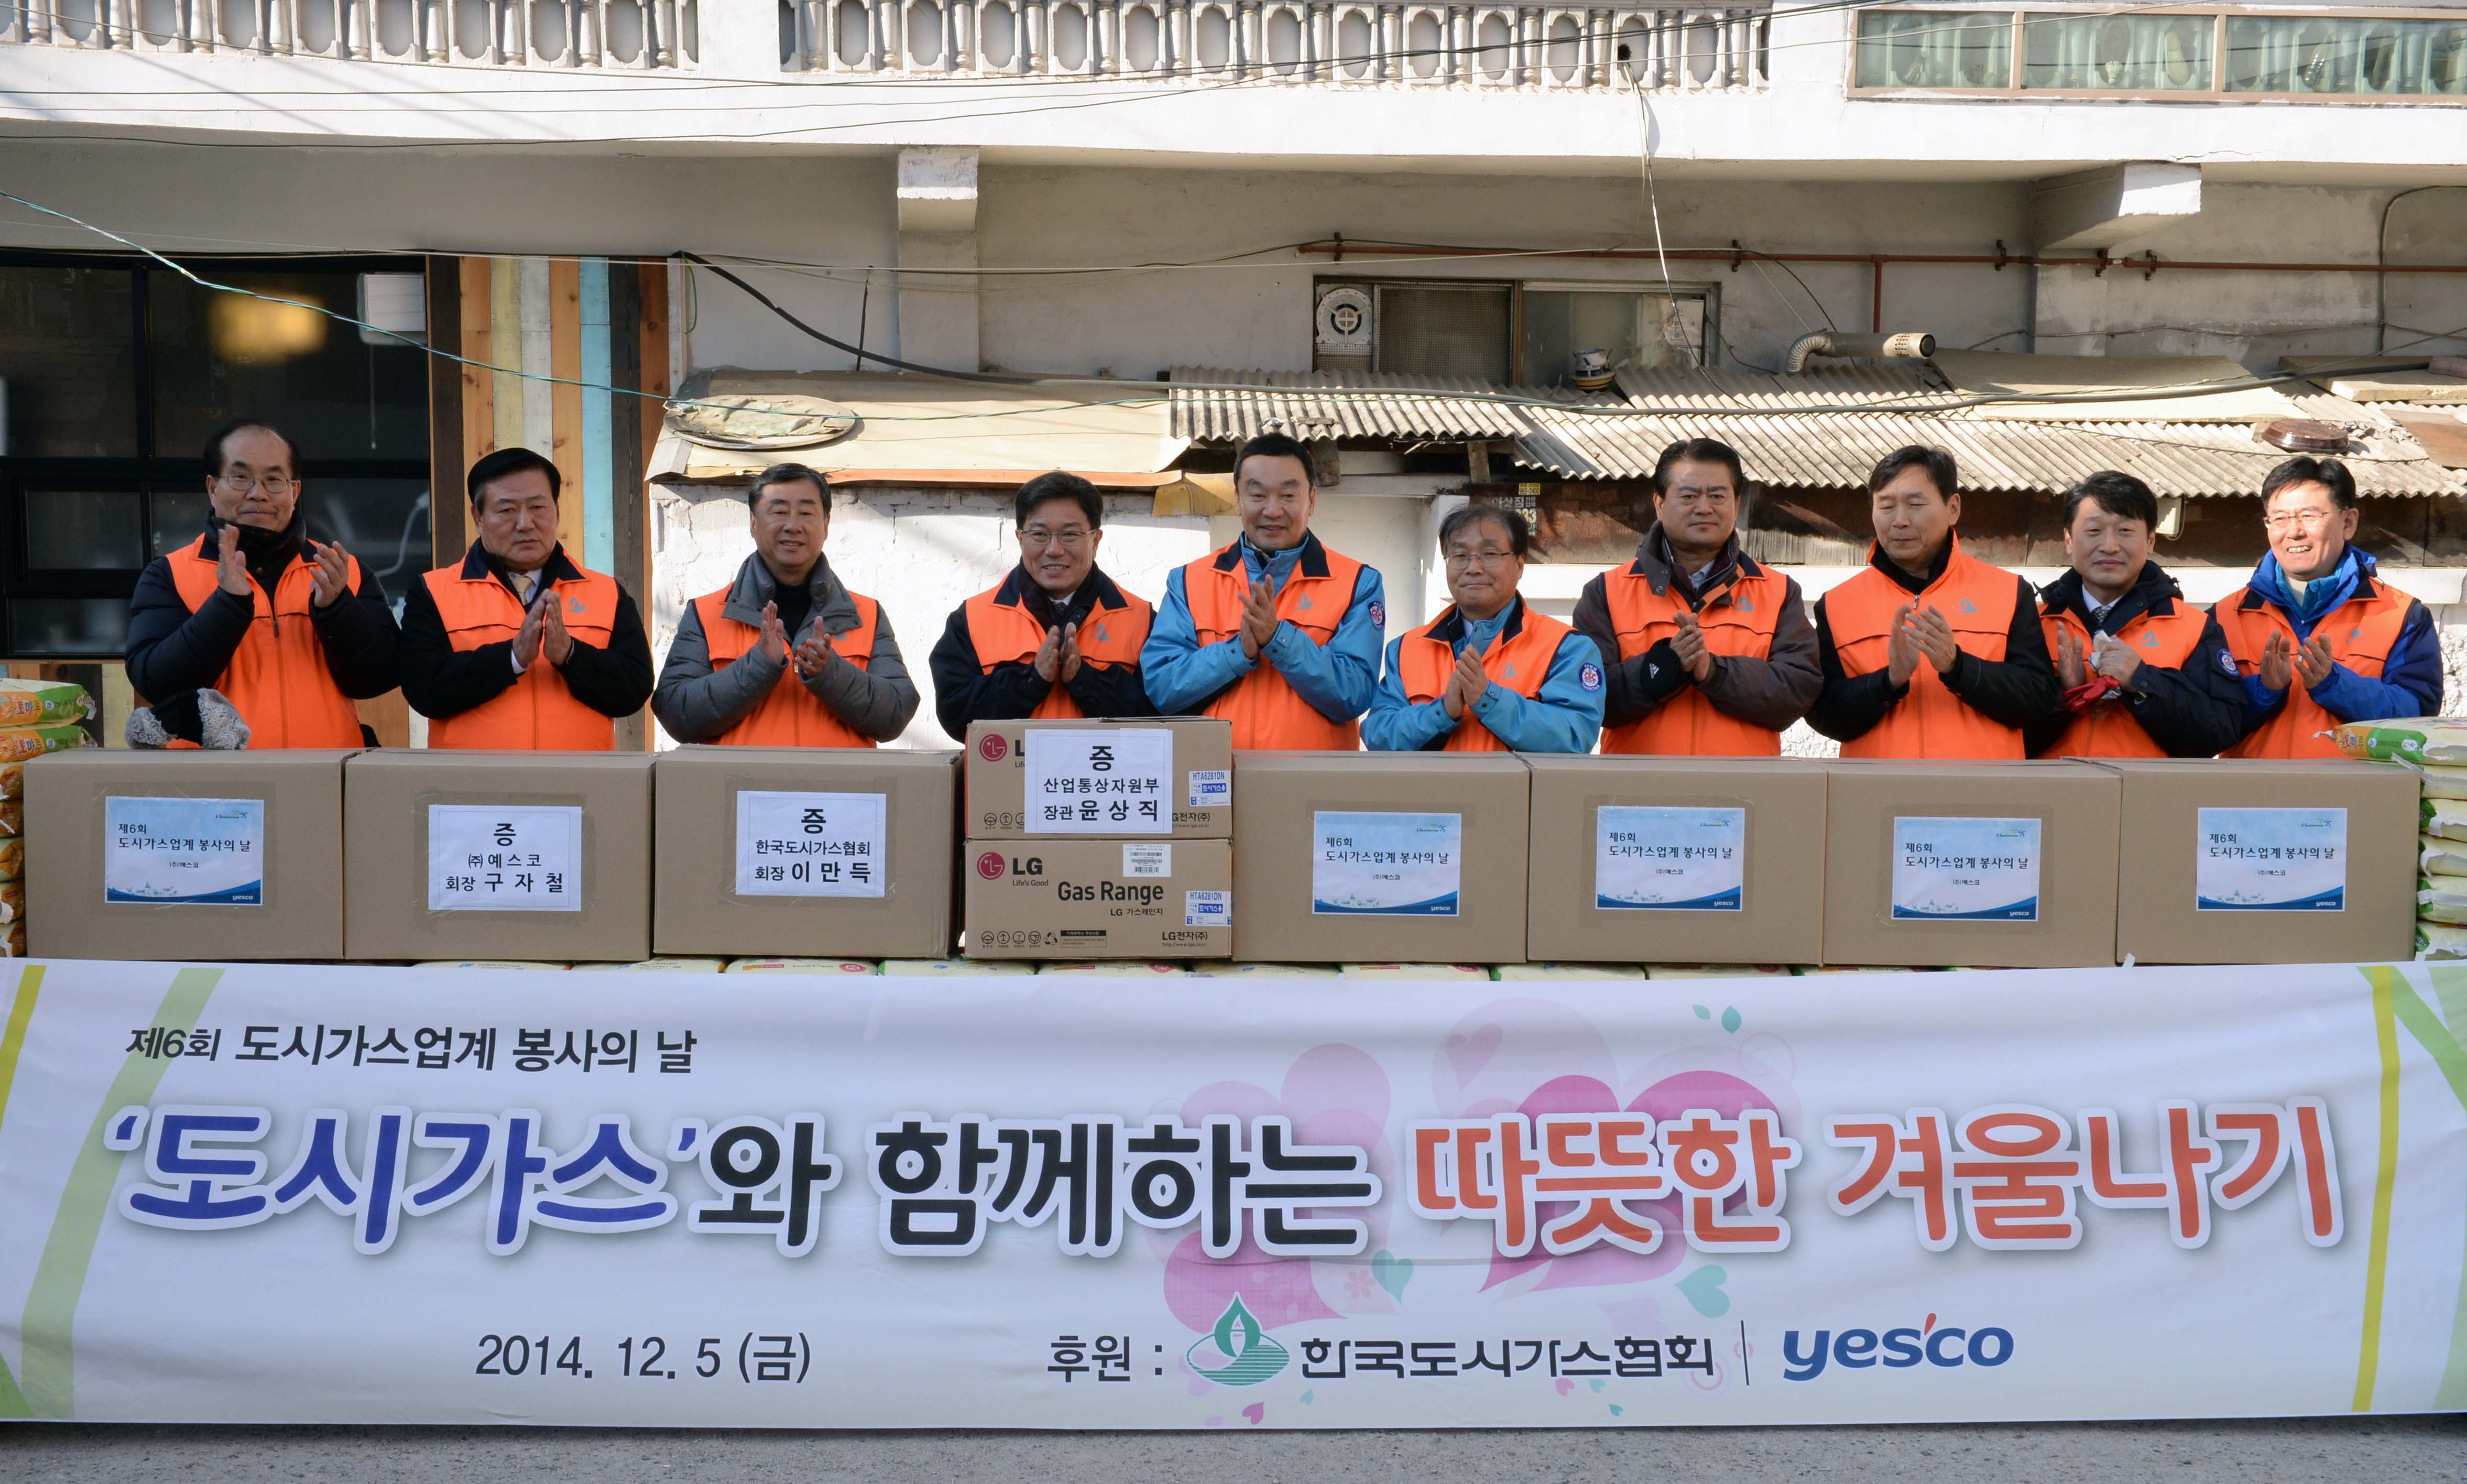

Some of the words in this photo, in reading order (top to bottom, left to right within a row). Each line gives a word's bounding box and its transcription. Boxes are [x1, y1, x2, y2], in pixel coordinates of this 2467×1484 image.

[1015, 740, 1024, 756] L
[1089, 746, 1114, 771] 증
[1193, 772, 1225, 781] HTA6281DN
[1044, 778, 1159, 793] 산업통상자원부
[1044, 805, 1073, 820] 장관
[801, 809, 826, 834] 증
[119, 824, 146, 834] 제6회
[494, 824, 516, 846] 증
[1326, 838, 1351, 847] 제6회
[1610, 833, 1635, 842] 제6회
[2210, 834, 2236, 843] 제6회
[119, 838, 193, 850] 도시가스업계
[199, 839, 234, 851] 봉사의
[240, 841, 250, 852] 날
[756, 840, 869, 856] 한국도시가스협회
[1610, 846, 1678, 857] 도시가스업계
[1684, 847, 1717, 858] 봉사의
[1722, 848, 1732, 858] 날
[1906, 843, 1931, 853] 제6회
[1326, 851, 1395, 863] 도시가스업계
[1400, 853, 1433, 864] 봉사의
[1439, 853, 1449, 864] 날
[2210, 847, 2280, 858] 도시가스업계
[2286, 848, 2319, 859] 봉사의
[2324, 848, 2335, 859] 날
[1013, 858, 1042, 875] LG
[1906, 857, 1975, 868] 도시가스업계
[1980, 858, 2013, 869] 봉사의
[2018, 858, 2028, 869] 날
[755, 866, 784, 881] 회장
[446, 877, 475, 891] 회장
[1058, 881, 1095, 901] Gas
[1101, 881, 1163, 905] Range
[1190, 891, 1221, 900] HTA6281DN
[1162, 932, 1207, 940] LG전자(주)
[126, 1027, 221, 1061] 제6회
[235, 1024, 496, 1070] 도시가스업계
[513, 1029, 637, 1073] 봉사의
[658, 1030, 697, 1073] 날
[876, 1122, 1371, 1250] 함께하는
[1416, 1118, 1791, 1247] 따뜻한
[1835, 1106, 2333, 1240] 겨울나기
[476, 1335, 592, 1378] 2014.
[618, 1337, 675, 1379] 12.
[696, 1339, 720, 1377] 5
[739, 1333, 810, 1383] (금)
[1301, 1336, 1713, 1378] 한국도시가스협회
